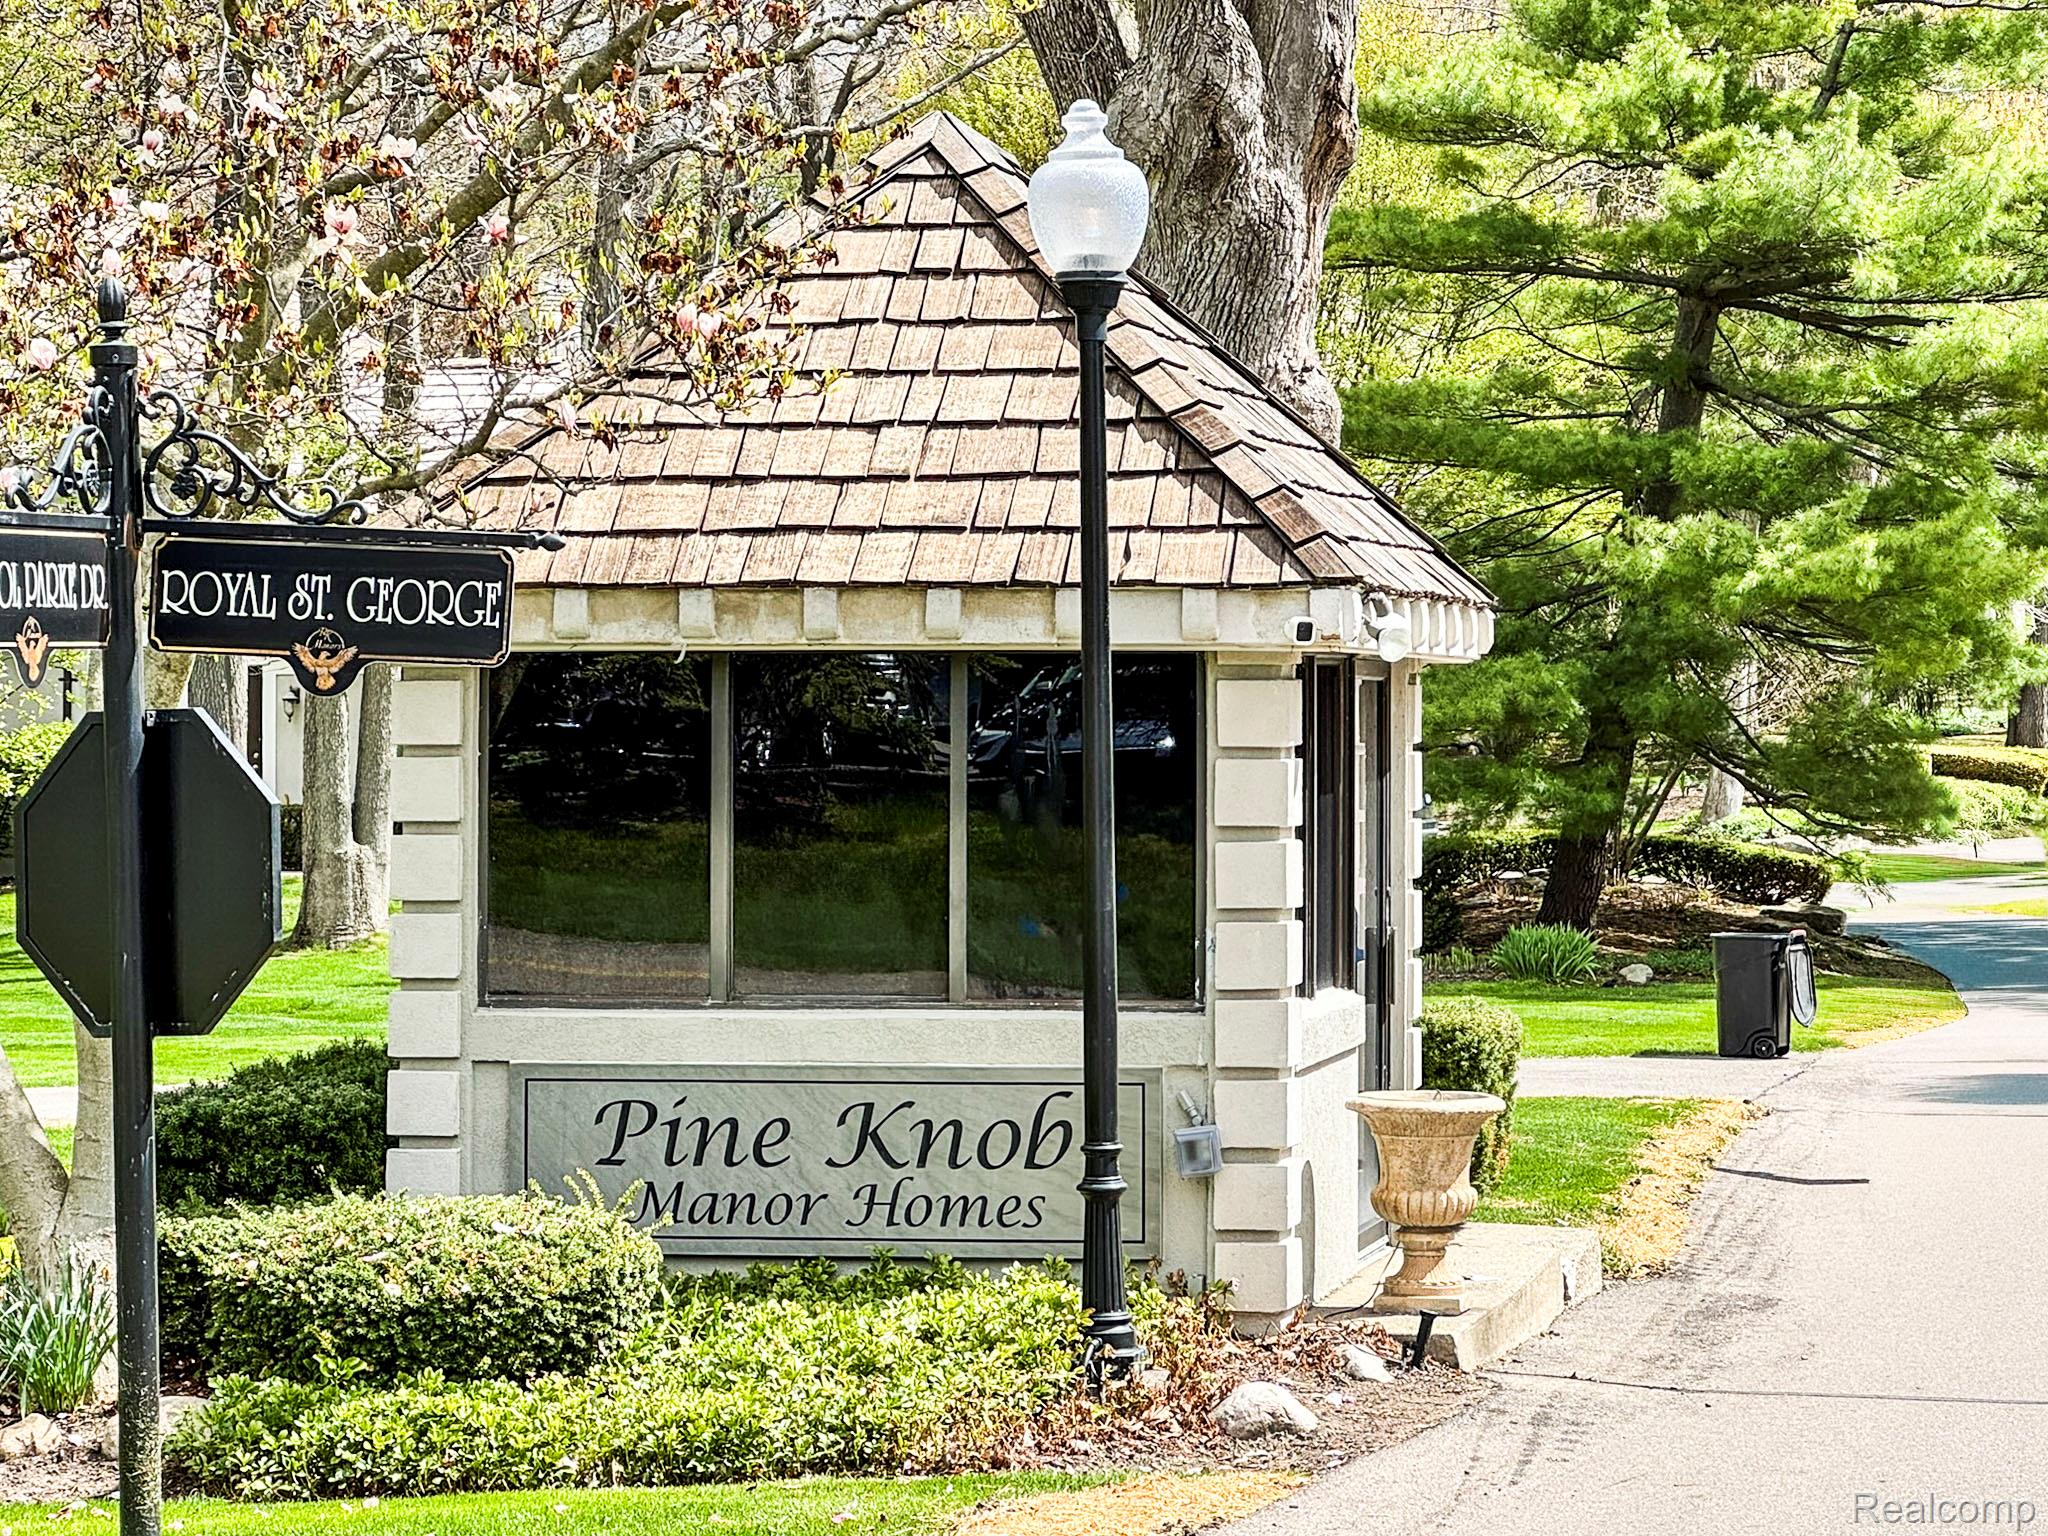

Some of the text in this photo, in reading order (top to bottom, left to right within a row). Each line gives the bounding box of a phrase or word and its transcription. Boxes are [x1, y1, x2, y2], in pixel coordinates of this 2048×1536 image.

[23, 561, 77, 610] PARKE
[160, 570, 502, 629] ROYAL ST. GEORGE
[594, 1091, 1074, 1170] Pine Knob
[627, 1177, 1046, 1228] Manor Homes
